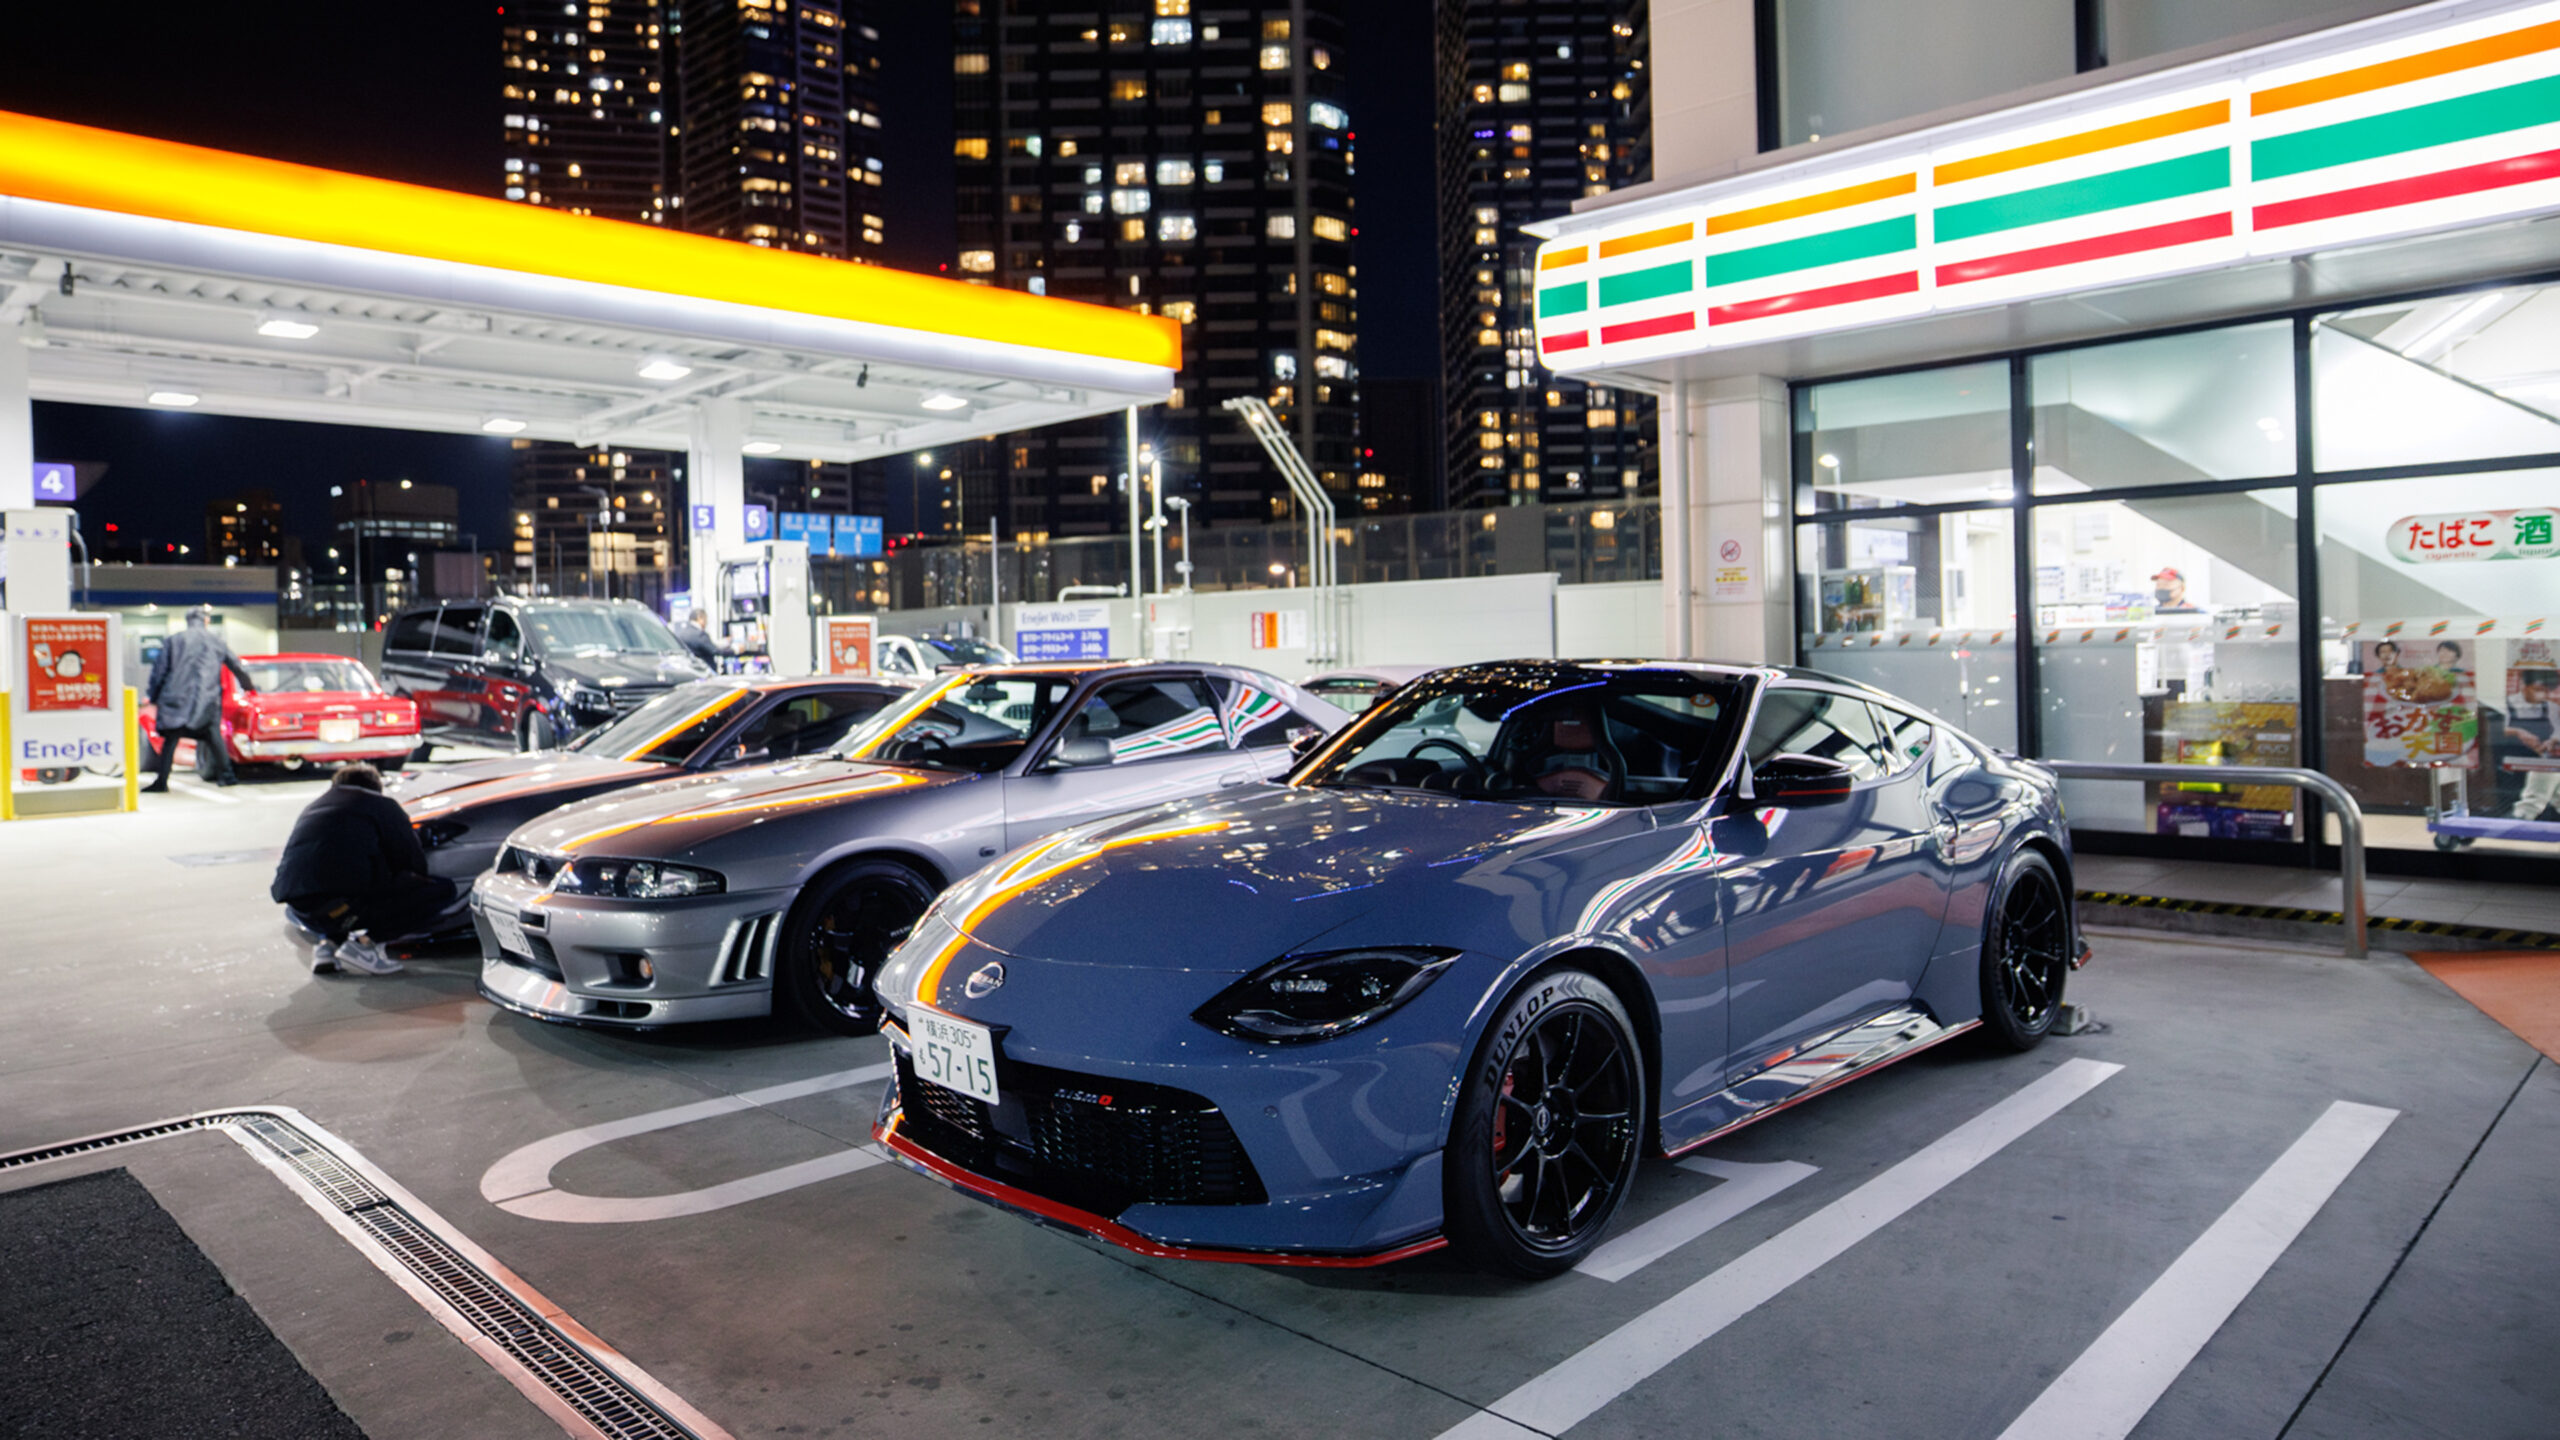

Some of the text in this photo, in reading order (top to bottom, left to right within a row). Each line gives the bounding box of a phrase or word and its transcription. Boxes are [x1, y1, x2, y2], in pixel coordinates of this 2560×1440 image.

[41, 470, 64, 494] 4
[697, 508, 710, 527] 5
[747, 510, 760, 529] 6
[2513, 514, 2553, 546] 酒
[2409, 518, 2494, 550] たばこ
[1050, 611, 1075, 623] Wash
[2401, 732, 2462, 759] 天国
[1485, 986, 1554, 1093] DUNLOP
[928, 1041, 992, 1096] 57-15
